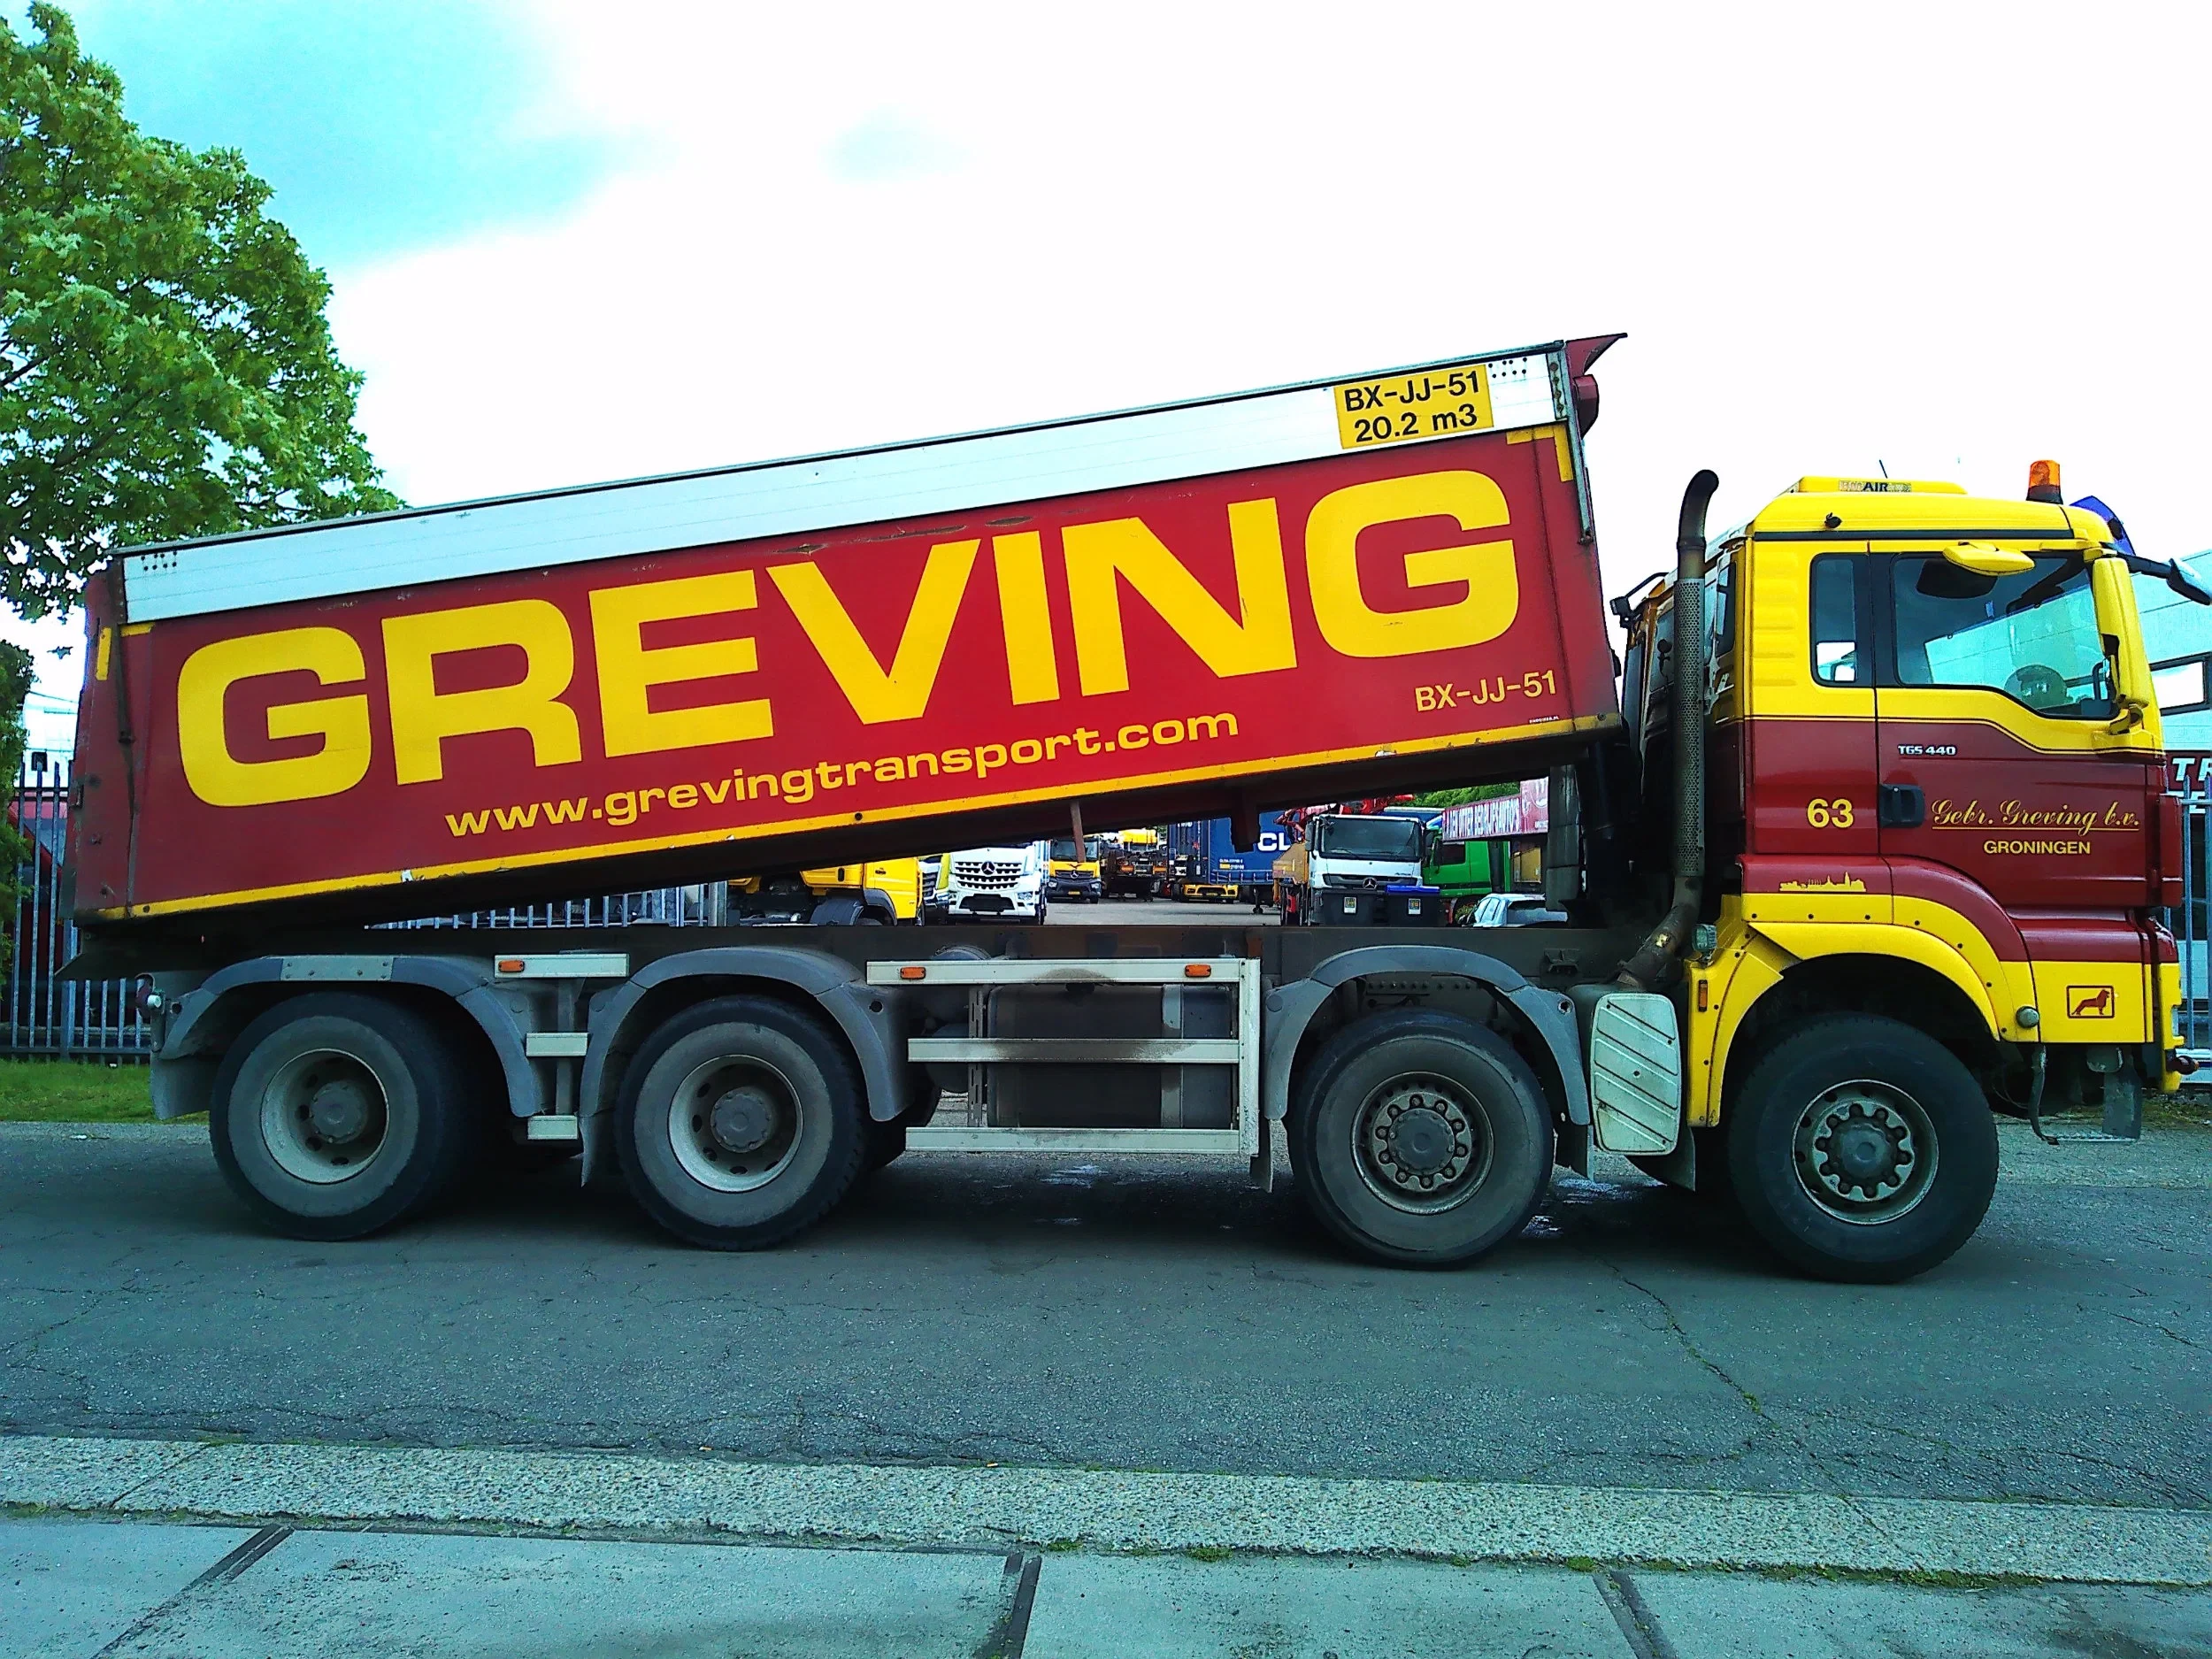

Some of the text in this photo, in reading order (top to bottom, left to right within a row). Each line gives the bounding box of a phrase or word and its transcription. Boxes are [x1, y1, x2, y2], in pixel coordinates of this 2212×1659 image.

[1344, 370, 1480, 412] BX-JJ-51
[1354, 403, 1478, 443] 20.2 m3
[178, 469, 1519, 807] GREVING
[1415, 670, 1557, 712] BX-JJ-51
[1898, 744, 1956, 756] TGS 440
[445, 712, 1239, 837] www.grevingtransport.com
[1806, 798, 1855, 829] 63
[1931, 800, 1993, 826] Gebr.
[1999, 800, 2098, 836] Greving
[2102, 800, 2140, 826] b.v.
[1983, 840, 2091, 855] GRONINGEN
